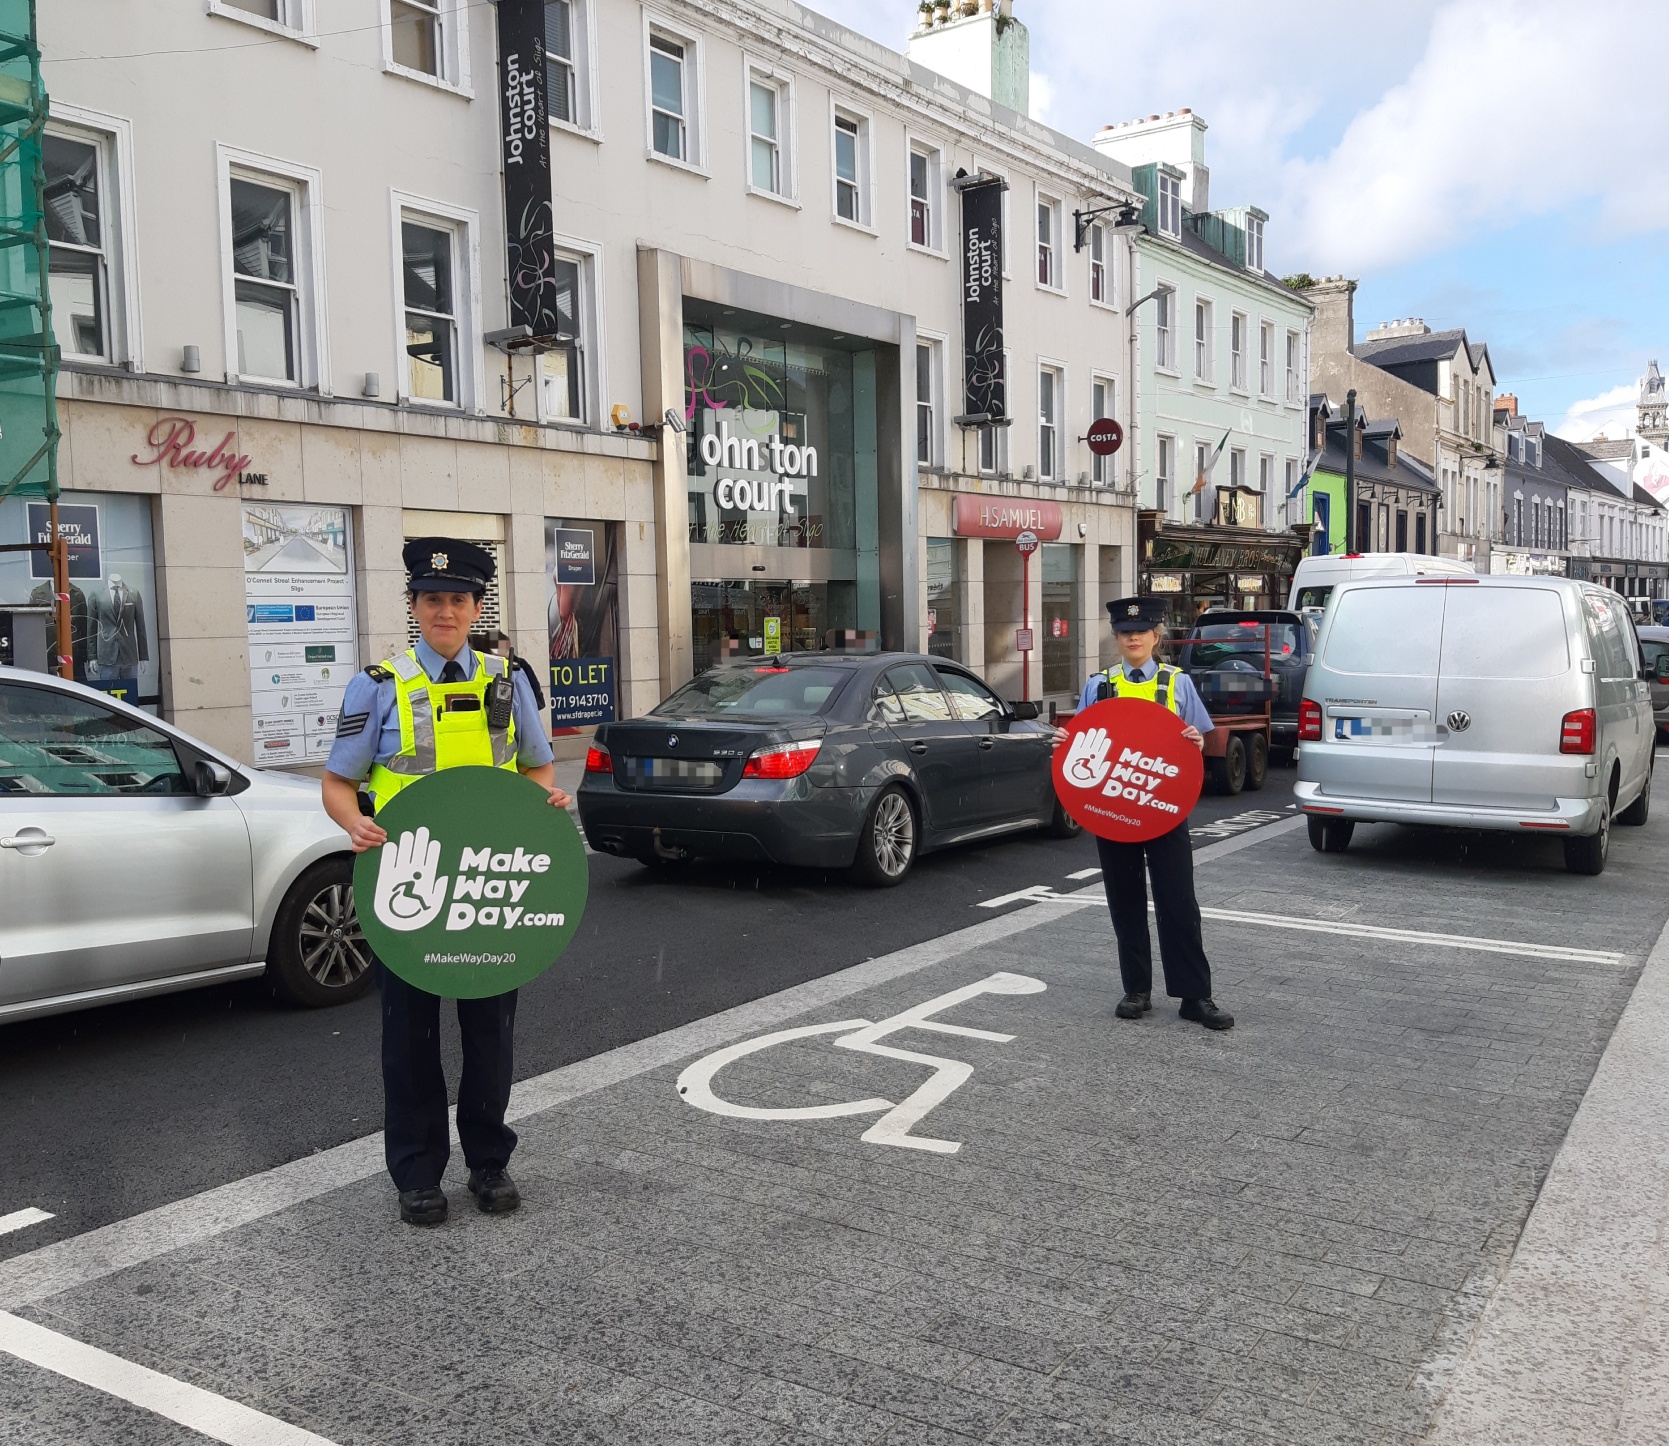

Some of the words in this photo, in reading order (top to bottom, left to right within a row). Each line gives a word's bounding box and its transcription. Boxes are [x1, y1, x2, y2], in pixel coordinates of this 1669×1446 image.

[533, 37, 545, 66] Sligo
[534, 71, 543, 84] of
[506, 53, 523, 165] Johnston
[520, 69, 536, 140] court
[537, 90, 545, 125] Heart
[539, 154, 547, 168] At
[990, 217, 1000, 238] Sligo
[992, 240, 998, 250] of
[966, 228, 980, 303] Johnston
[979, 239, 992, 286] court
[1090, 433, 1117, 442] COSTA
[131, 416, 252, 491] Ruby
[238, 471, 269, 486] LANE
[715, 477, 795, 514] court
[979, 506, 1045, 530] H.SAMUEL
[703, 520, 725, 538] the
[730, 519, 769, 541] Heart
[777, 520, 790, 537] of
[793, 518, 824, 543] Sligo
[560, 550, 589, 560] FitzGerald
[564, 542, 584, 552] Sherry
[1019, 543, 1035, 551] BUS
[551, 666, 573, 686] TO
[578, 664, 608, 685] LET
[550, 695, 566, 709] 071
[569, 693, 609, 708] 9143710
[556, 709, 603, 721] www.sfdraper.ie
[1119, 747, 1179, 777] Make
[1110, 764, 1162, 790] Way
[1102, 779, 1180, 814] Day.com
[1084, 803, 1141, 827] #MakeWayDay20
[459, 847, 551, 873] Make
[452, 875, 530, 903] Way
[445, 902, 565, 931] Day.com
[424, 953, 516, 966] #MakeWayDay20
